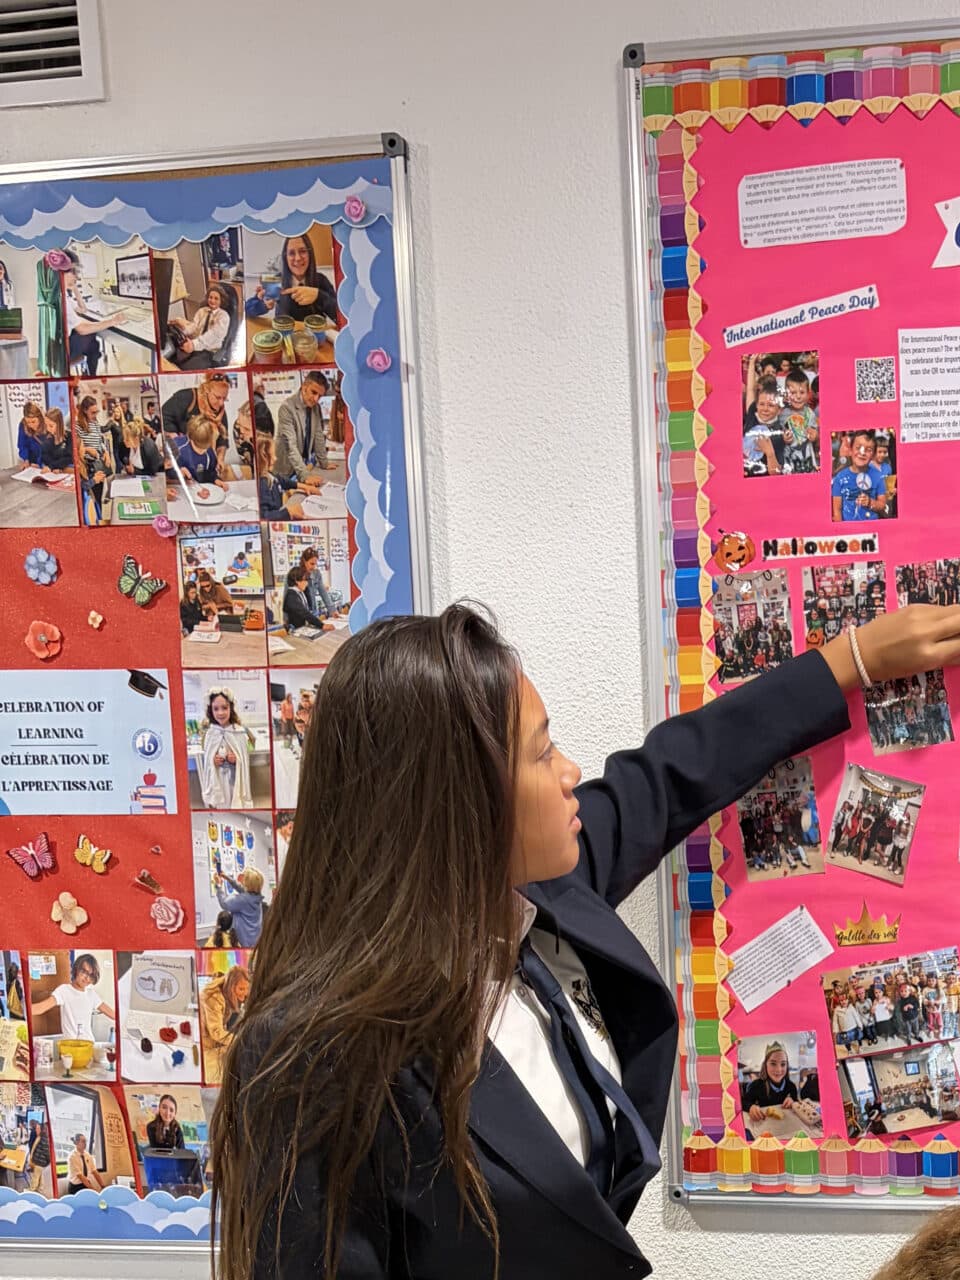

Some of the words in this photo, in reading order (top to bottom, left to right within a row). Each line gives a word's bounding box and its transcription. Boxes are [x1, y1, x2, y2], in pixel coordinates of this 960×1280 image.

[726, 310, 807, 343] International
[808, 303, 845, 319] Peace
[849, 295, 876, 309] Day
[87, 701, 104, 712] OF
[18, 728, 84, 740] LEARNING
[1, 752, 90, 765] CÉLÉBRATION
[93, 754, 110, 765] DE
[2, 780, 113, 792] L'APPRENTISSAGE
